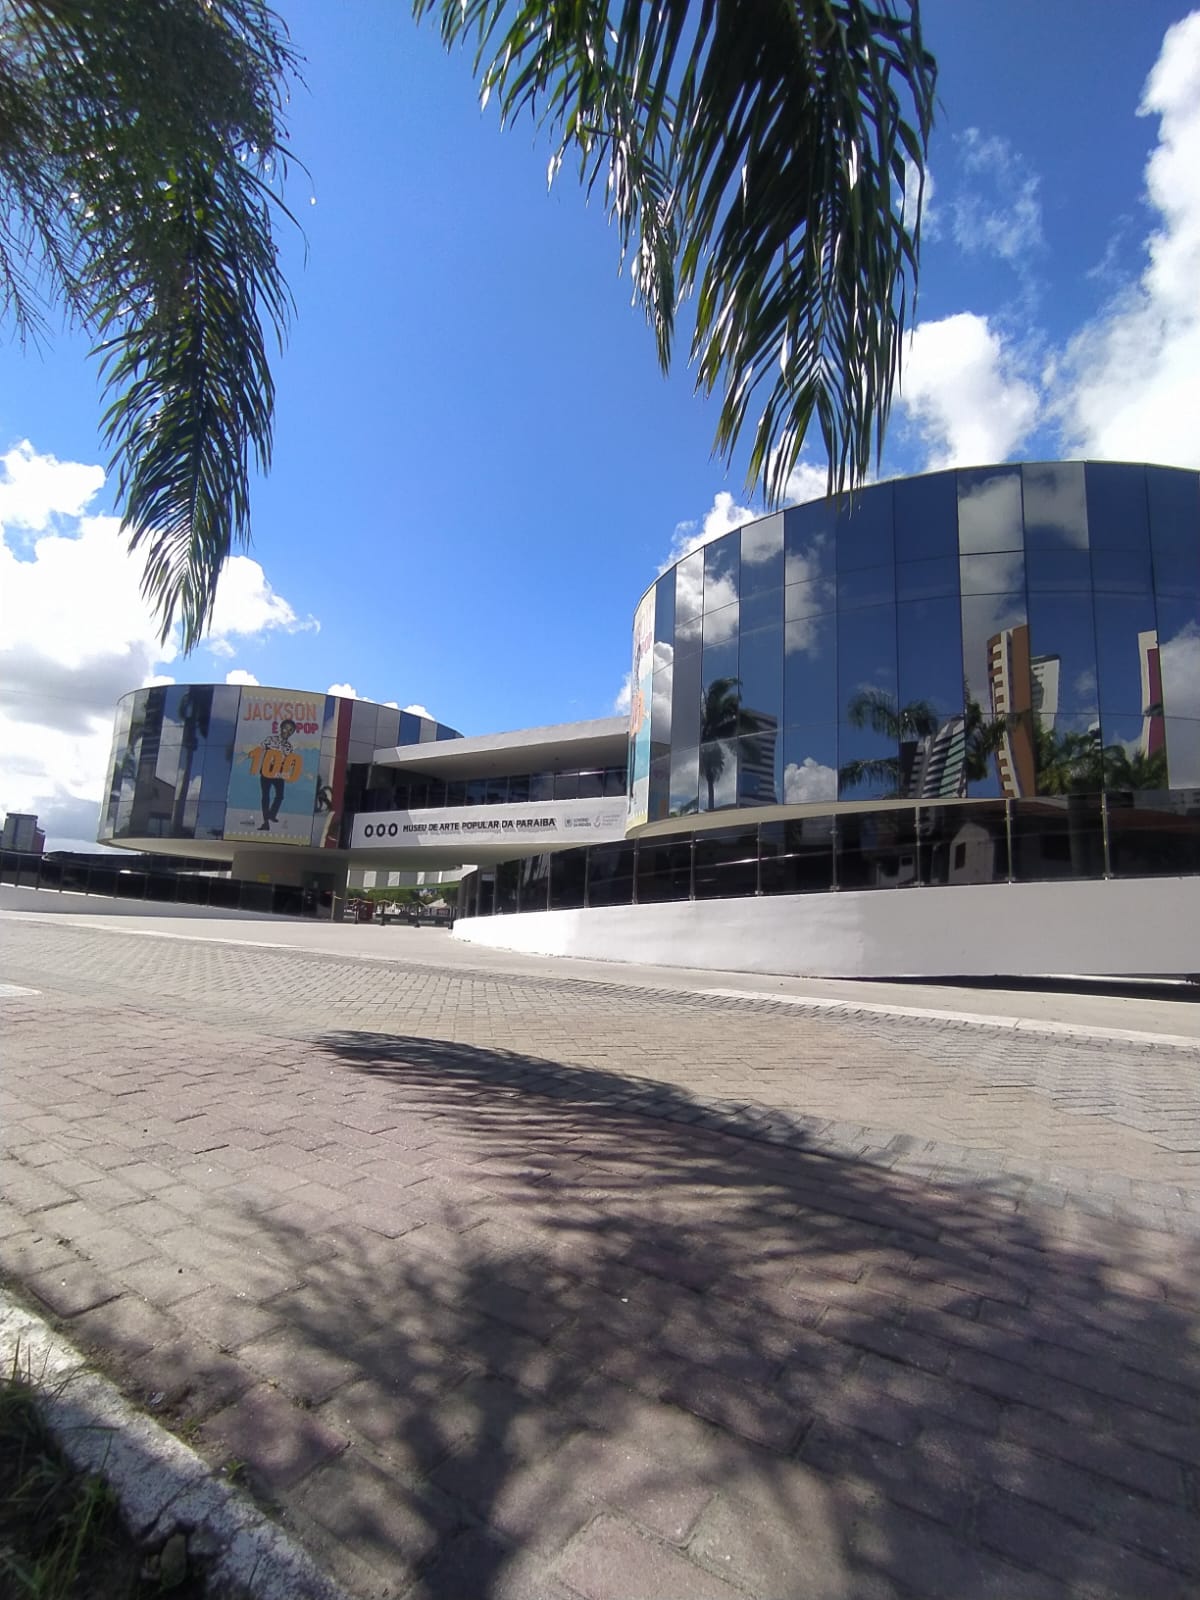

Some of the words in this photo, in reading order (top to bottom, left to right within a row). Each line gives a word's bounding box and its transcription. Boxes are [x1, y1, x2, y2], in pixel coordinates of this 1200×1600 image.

[243, 702, 317, 721] JACKSON
[295, 721, 319, 734] POP
[248, 747, 303, 783] 100
[403, 823, 427, 832] MUSEU
[428, 823, 438, 831] DE
[439, 822, 459, 831] ARTE
[461, 821, 499, 830] POPULAR
[501, 820, 514, 829] DA
